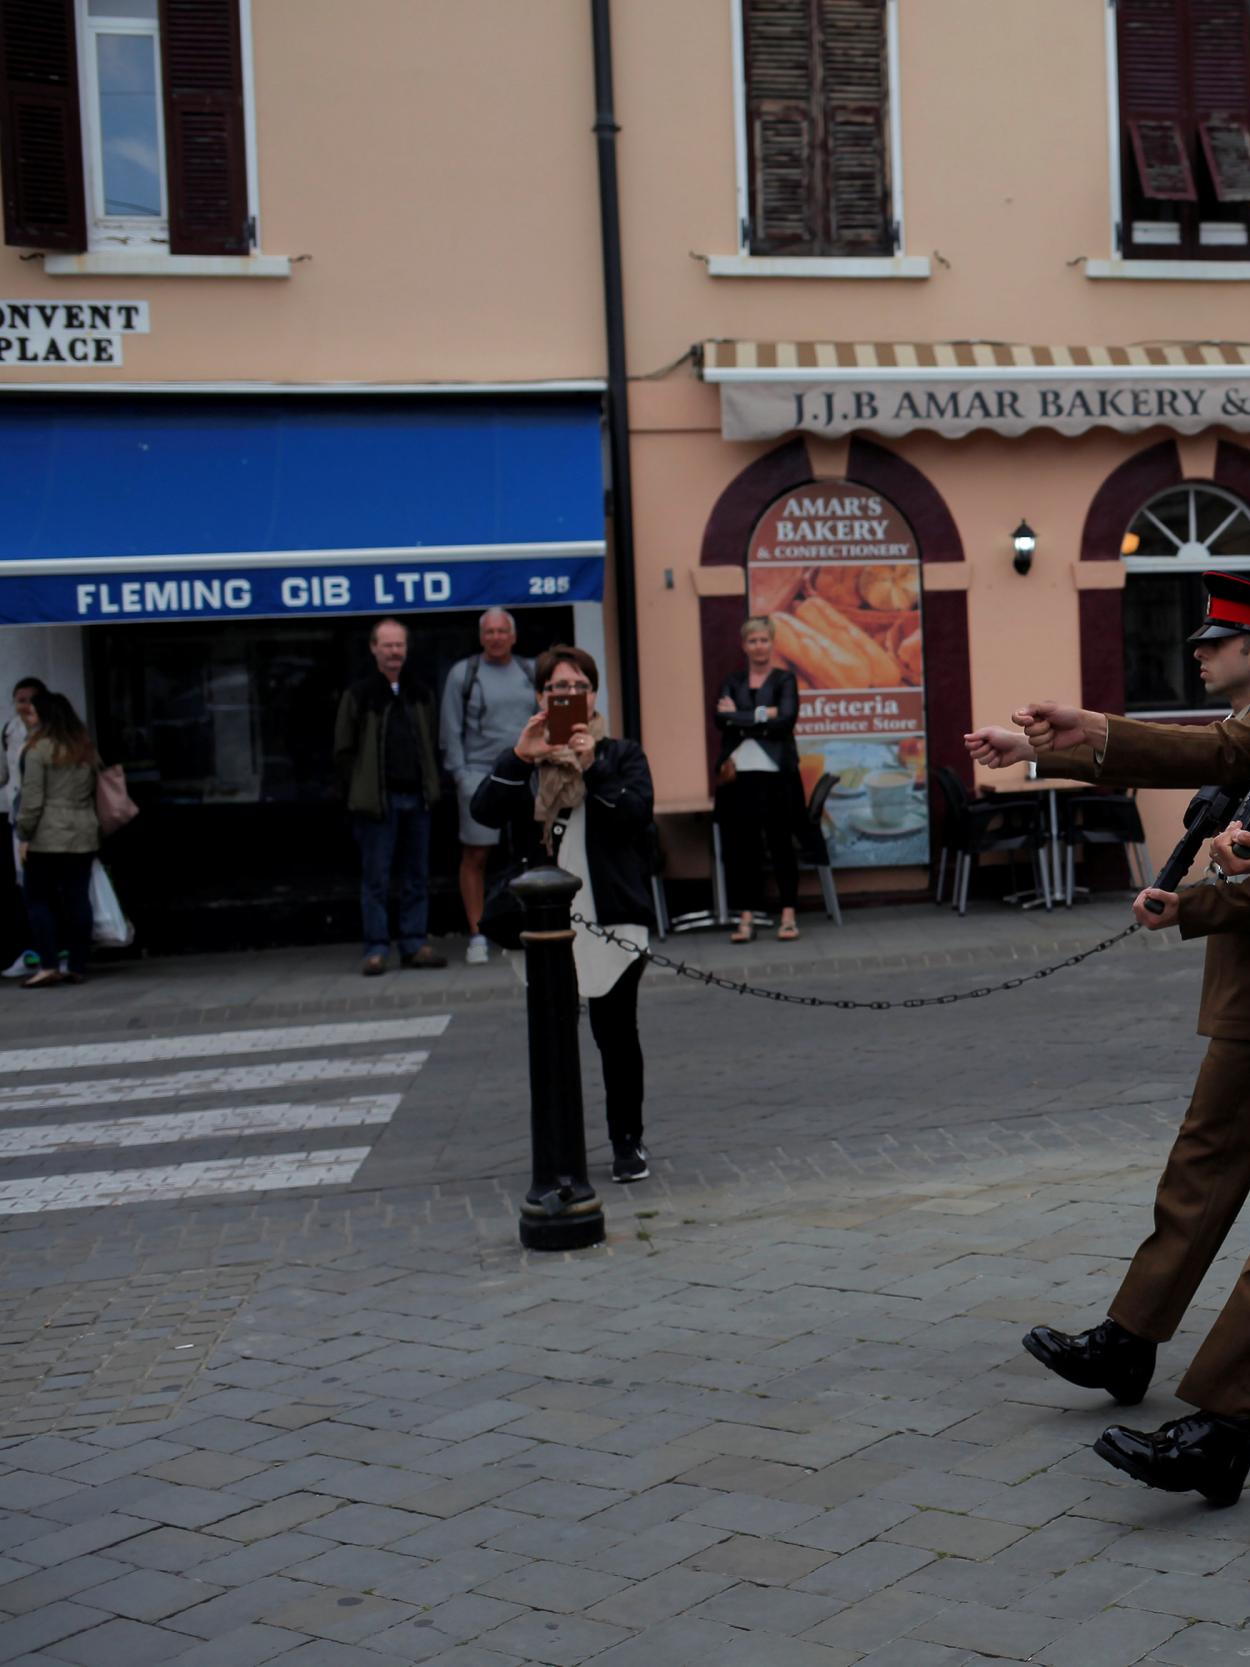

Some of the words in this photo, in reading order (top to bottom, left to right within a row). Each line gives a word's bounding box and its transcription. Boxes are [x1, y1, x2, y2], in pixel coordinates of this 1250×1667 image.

[0, 303, 140, 330] NVENT
[891, 389, 1026, 420] AMAR
[1038, 387, 1207, 419] BAKERY
[783, 496, 883, 519] AMAR'S
[776, 519, 890, 542] BAKERY
[757, 546, 771, 560] &
[774, 543, 910, 559] CONFECTIONERY
[76, 577, 252, 615] FLEMING
[281, 574, 351, 608] GIB
[373, 570, 452, 605] LTD
[528, 575, 571, 596] 285
[799, 695, 899, 718] afeteria
[795, 719, 869, 733] venience
[873, 717, 918, 731] Store
